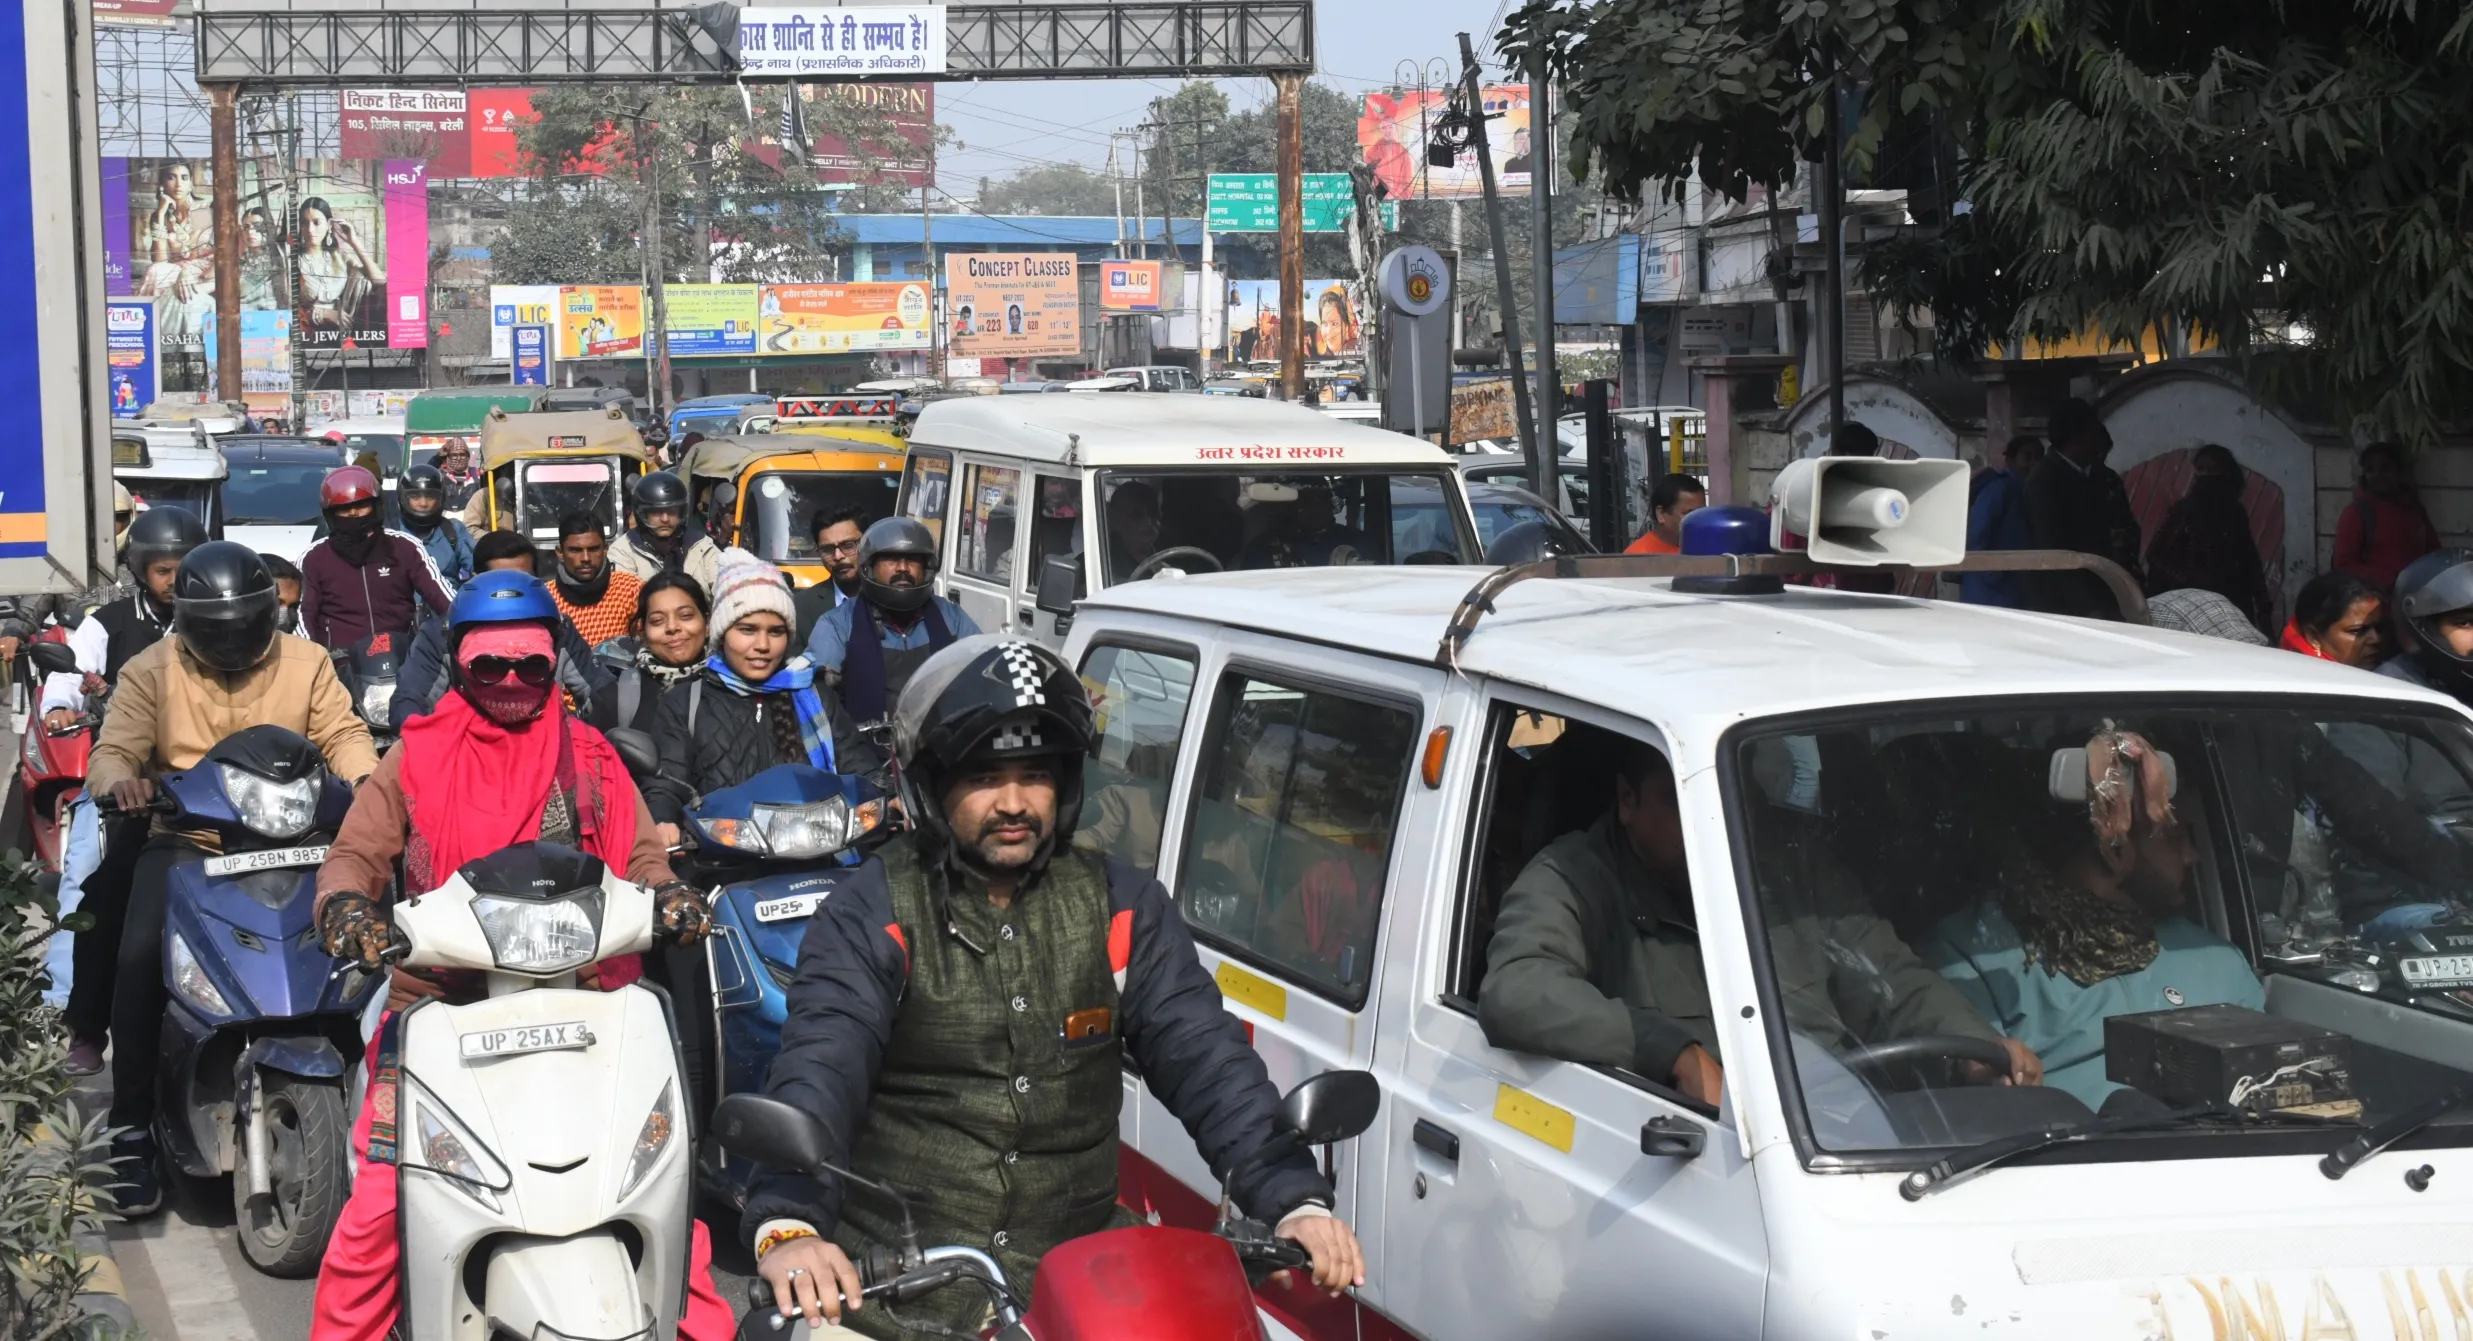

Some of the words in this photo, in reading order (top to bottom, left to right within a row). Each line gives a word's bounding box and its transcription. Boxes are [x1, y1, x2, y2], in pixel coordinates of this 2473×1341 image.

[772, 14, 815, 51] शान्ति
[820, 14, 835, 51] से
[840, 15, 858, 51] ही
[862, 22, 905, 51] सम्भव
[908, 14, 928, 51] है।
[767, 58, 791, 69] नाथ
[796, 55, 863, 72] (प्रशासनिक
[868, 54, 926, 72] अधिकारी)
[347, 90, 384, 107] निकट
[389, 92, 417, 108] हिन्द
[422, 92, 464, 109] सिनेमा
[347, 119, 367, 131] 105,
[439, 117, 464, 131] बरेली
[388, 173, 416, 185] HSJ
[1210, 218, 1239, 226] LUCKNOW
[969, 257, 1020, 277] CONCEPT
[1024, 257, 1070, 276] CLASSES
[1129, 273, 1148, 286] LIC
[519, 306, 548, 324] LIC
[736, 321, 751, 333] LIC
[986, 319, 1002, 332] 223
[1027, 320, 1039, 330] 620
[313, 330, 386, 344] JEWLERS
[1195, 447, 1235, 459] उत्तर
[1240, 444, 1282, 459] प्रदेश
[1287, 446, 1345, 459] सरकार
[223, 857, 240, 871] UP
[248, 851, 286, 867] 25BN
[292, 847, 328, 862] 9857
[788, 878, 836, 891] HONDA
[2450, 958, 2473, 975] 25
[482, 1033, 506, 1051] UP
[517, 1026, 567, 1048] 25AX
